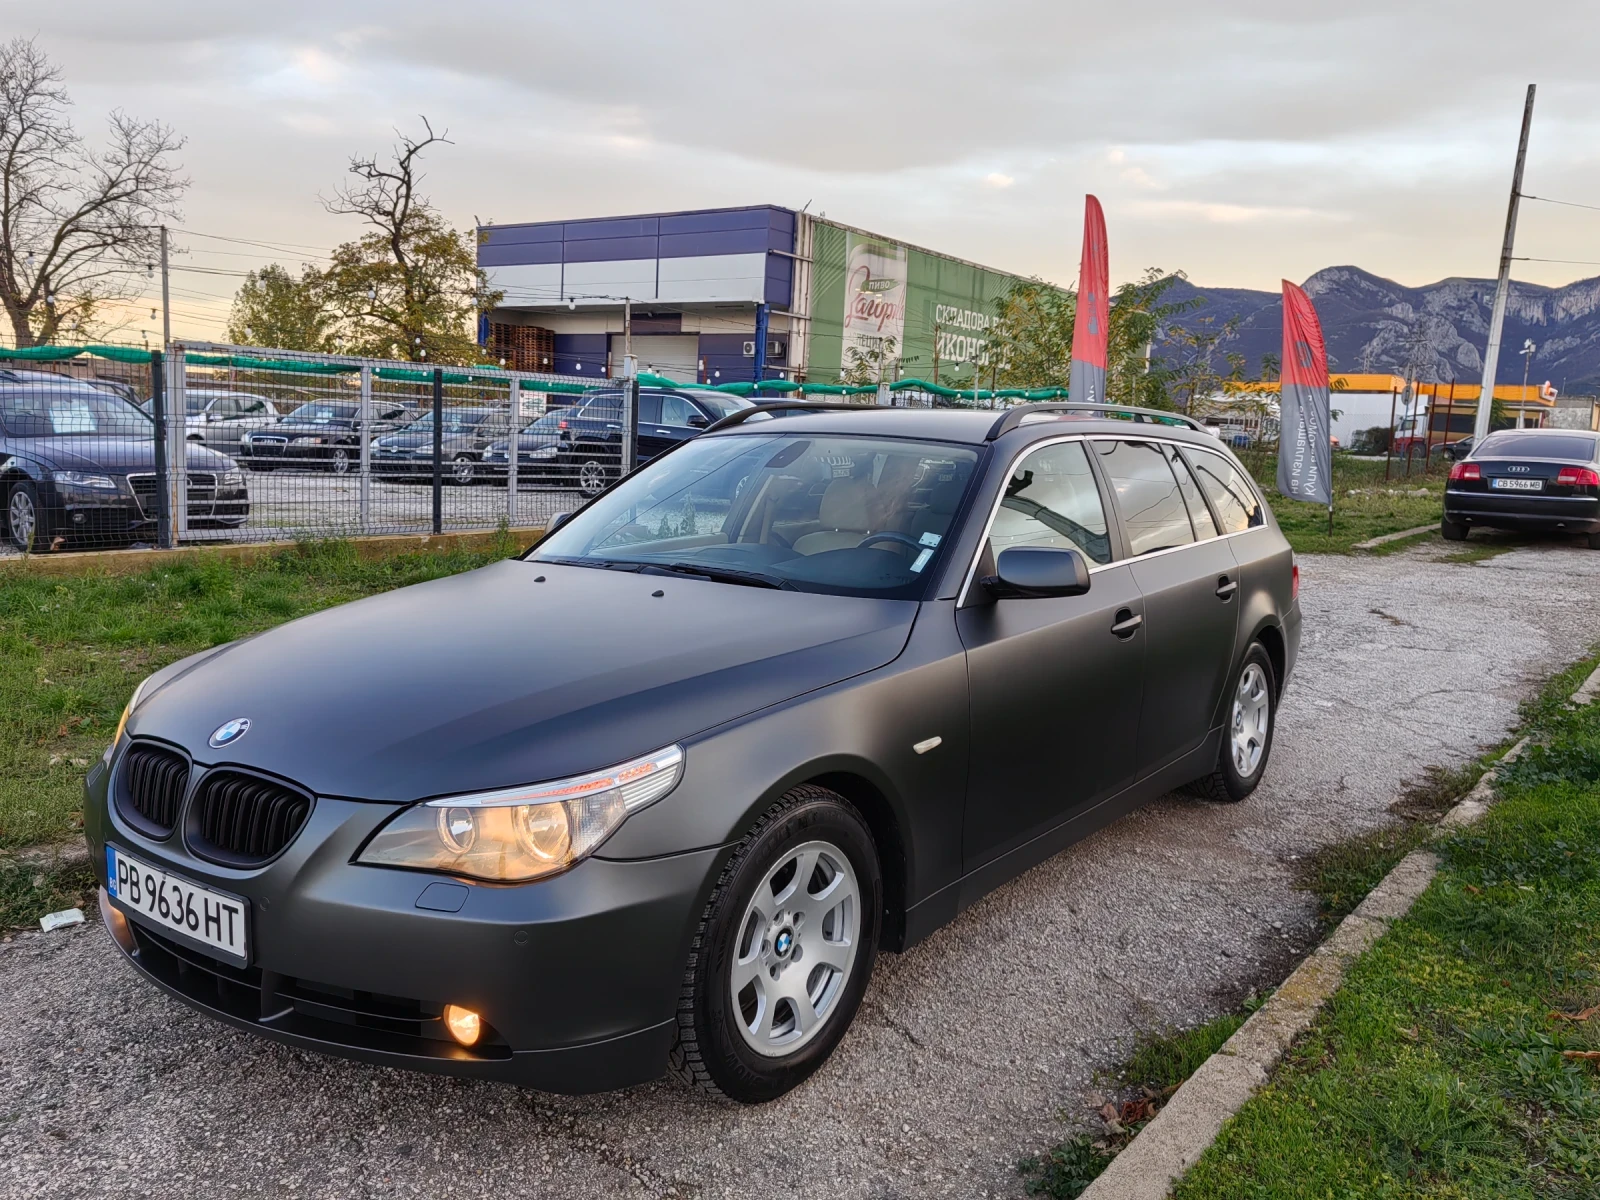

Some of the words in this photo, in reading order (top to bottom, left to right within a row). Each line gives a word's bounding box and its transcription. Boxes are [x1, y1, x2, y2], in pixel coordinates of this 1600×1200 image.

[868, 280, 891, 290] ПИВО
[935, 304, 990, 331] СКЛАДОВА
[1509, 479, 1529, 489] 5966
[117, 857, 141, 905] PB
[145, 873, 200, 932] 9636
[204, 897, 239, 946] HT
